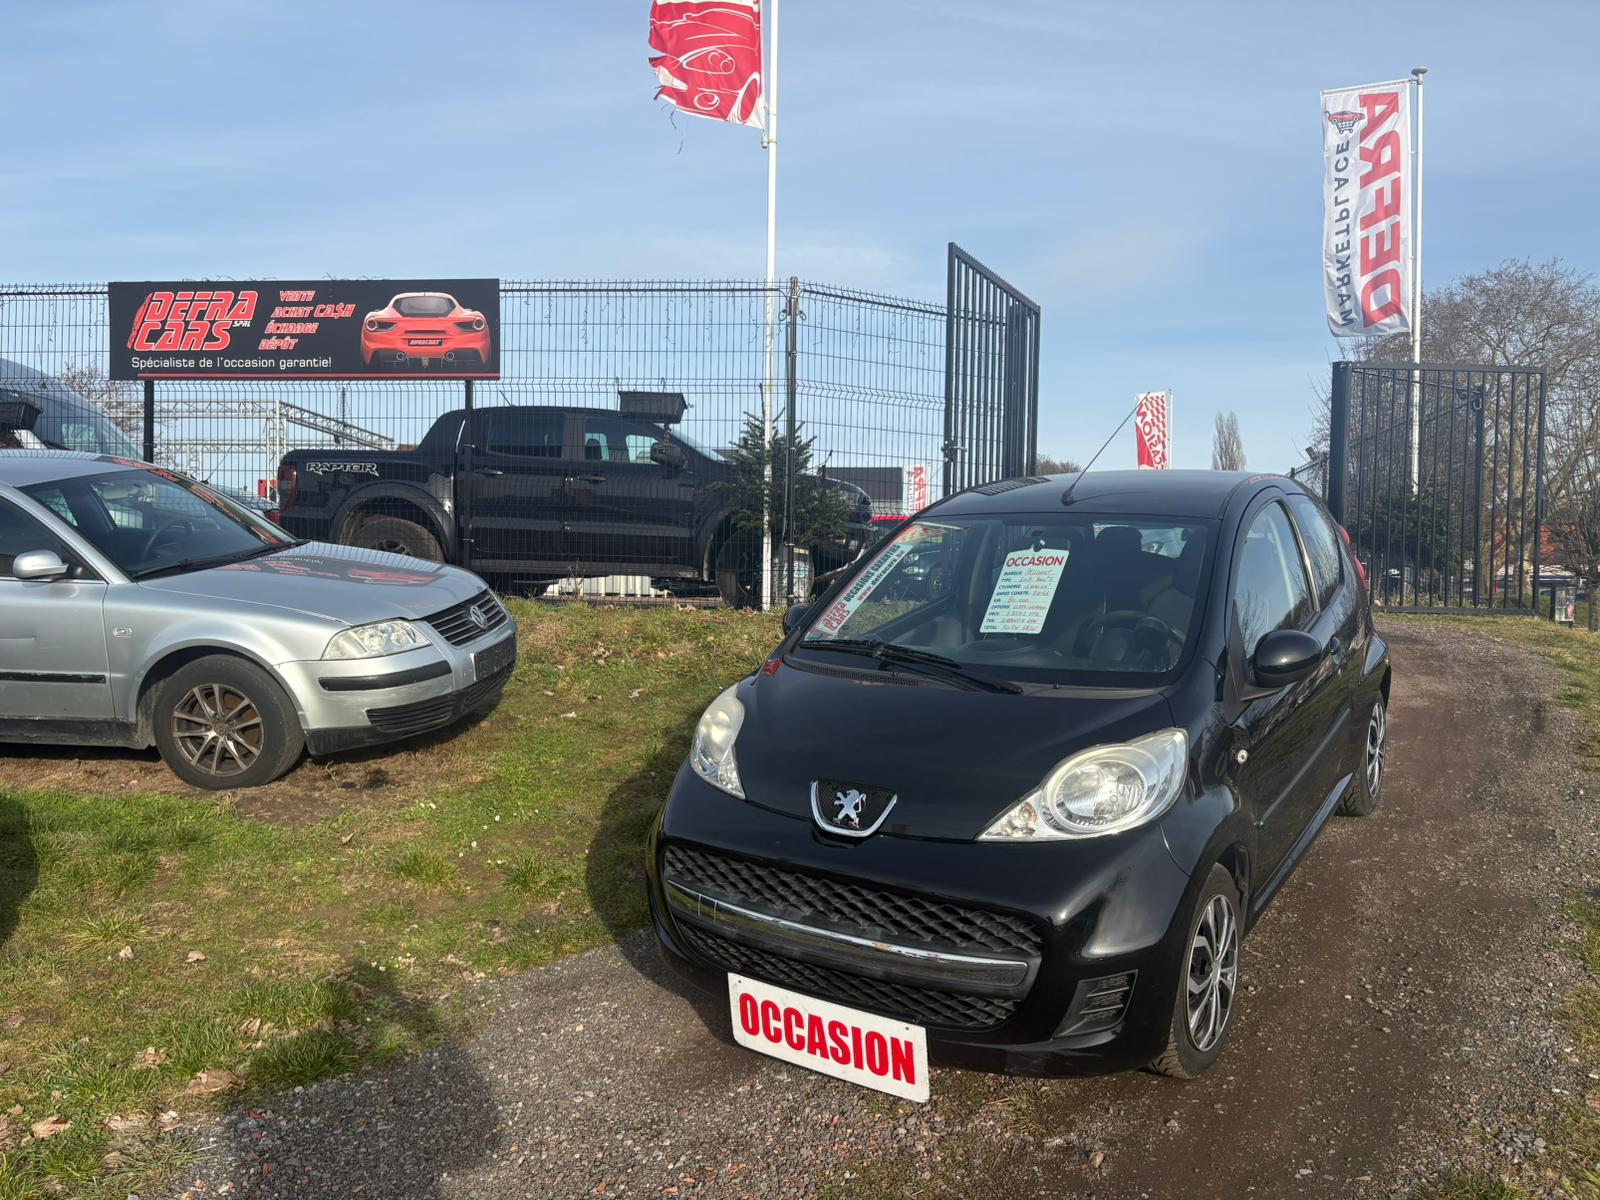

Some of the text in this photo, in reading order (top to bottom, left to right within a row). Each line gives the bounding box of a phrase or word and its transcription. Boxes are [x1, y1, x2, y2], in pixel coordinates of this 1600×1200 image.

[280, 290, 315, 301] VENTE
[144, 291, 258, 321] DEFRA
[271, 302, 356, 319] ACHAT CA$H
[265, 320, 319, 334] ÉCHANGE
[134, 320, 233, 351] CARS
[259, 335, 298, 350] DÉPÔT
[131, 357, 195, 370] Spécialiste
[199, 357, 213, 369] de
[217, 356, 276, 368] l'occasion
[306, 462, 379, 477] RAPTOR
[1006, 556, 1064, 567] OCCASION
[844, 570, 873, 602] OCCASIONS
[738, 992, 916, 1086] OCCASION
